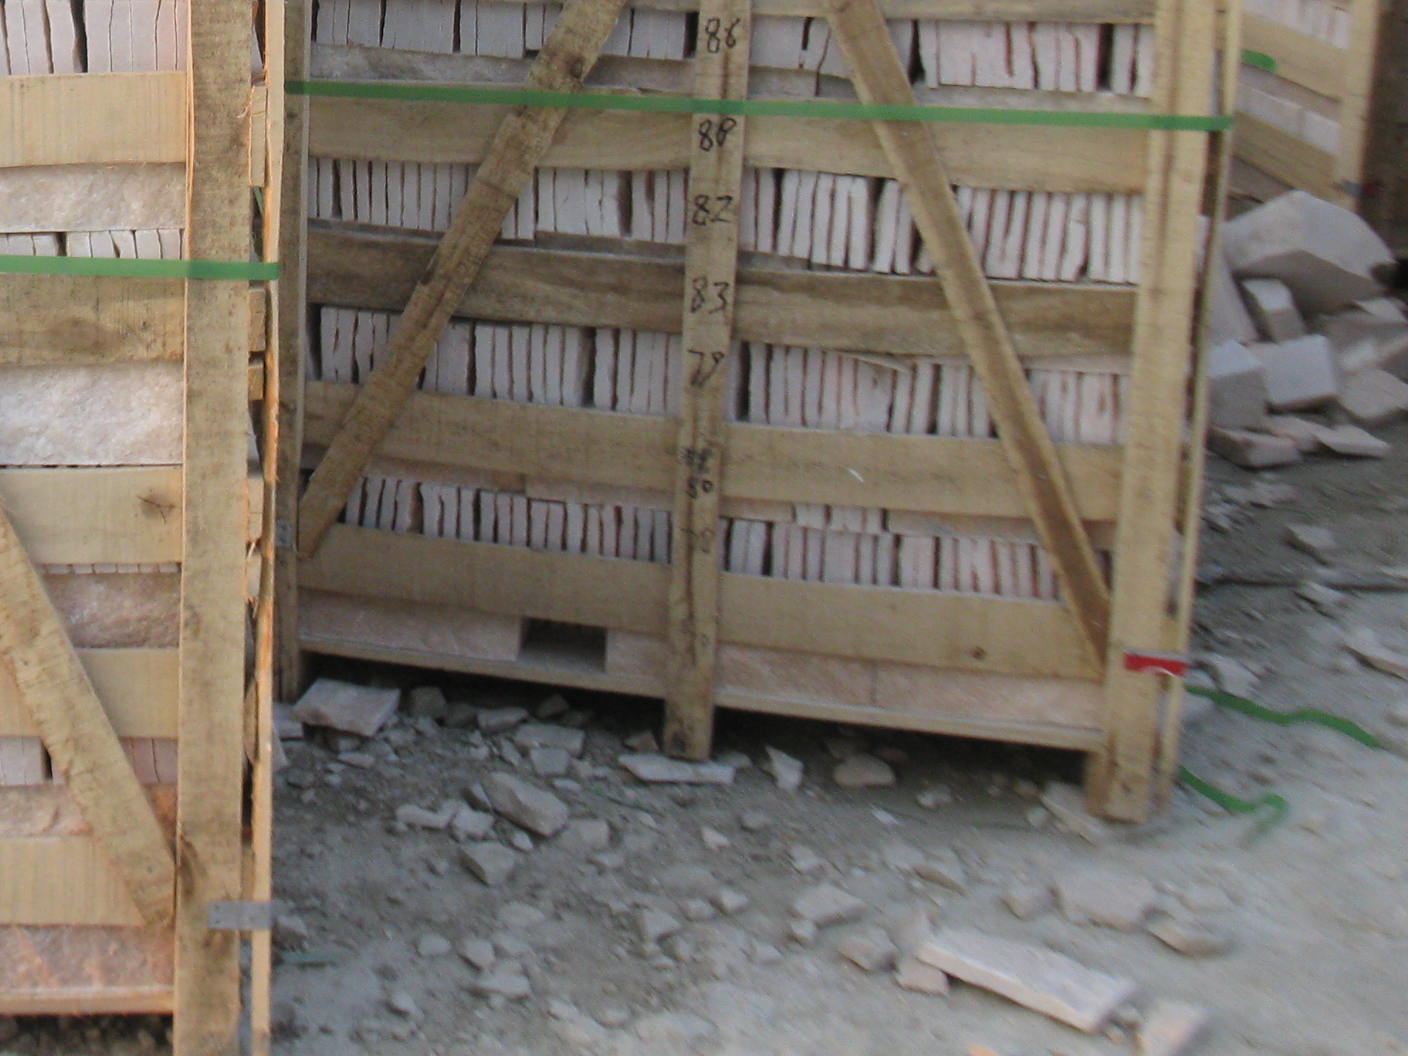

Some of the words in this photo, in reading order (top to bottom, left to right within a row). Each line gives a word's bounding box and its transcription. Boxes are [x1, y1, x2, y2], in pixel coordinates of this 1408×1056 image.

[705, 17, 741, 54] 86
[692, 194, 733, 226] 82
[690, 276, 730, 314] 83
